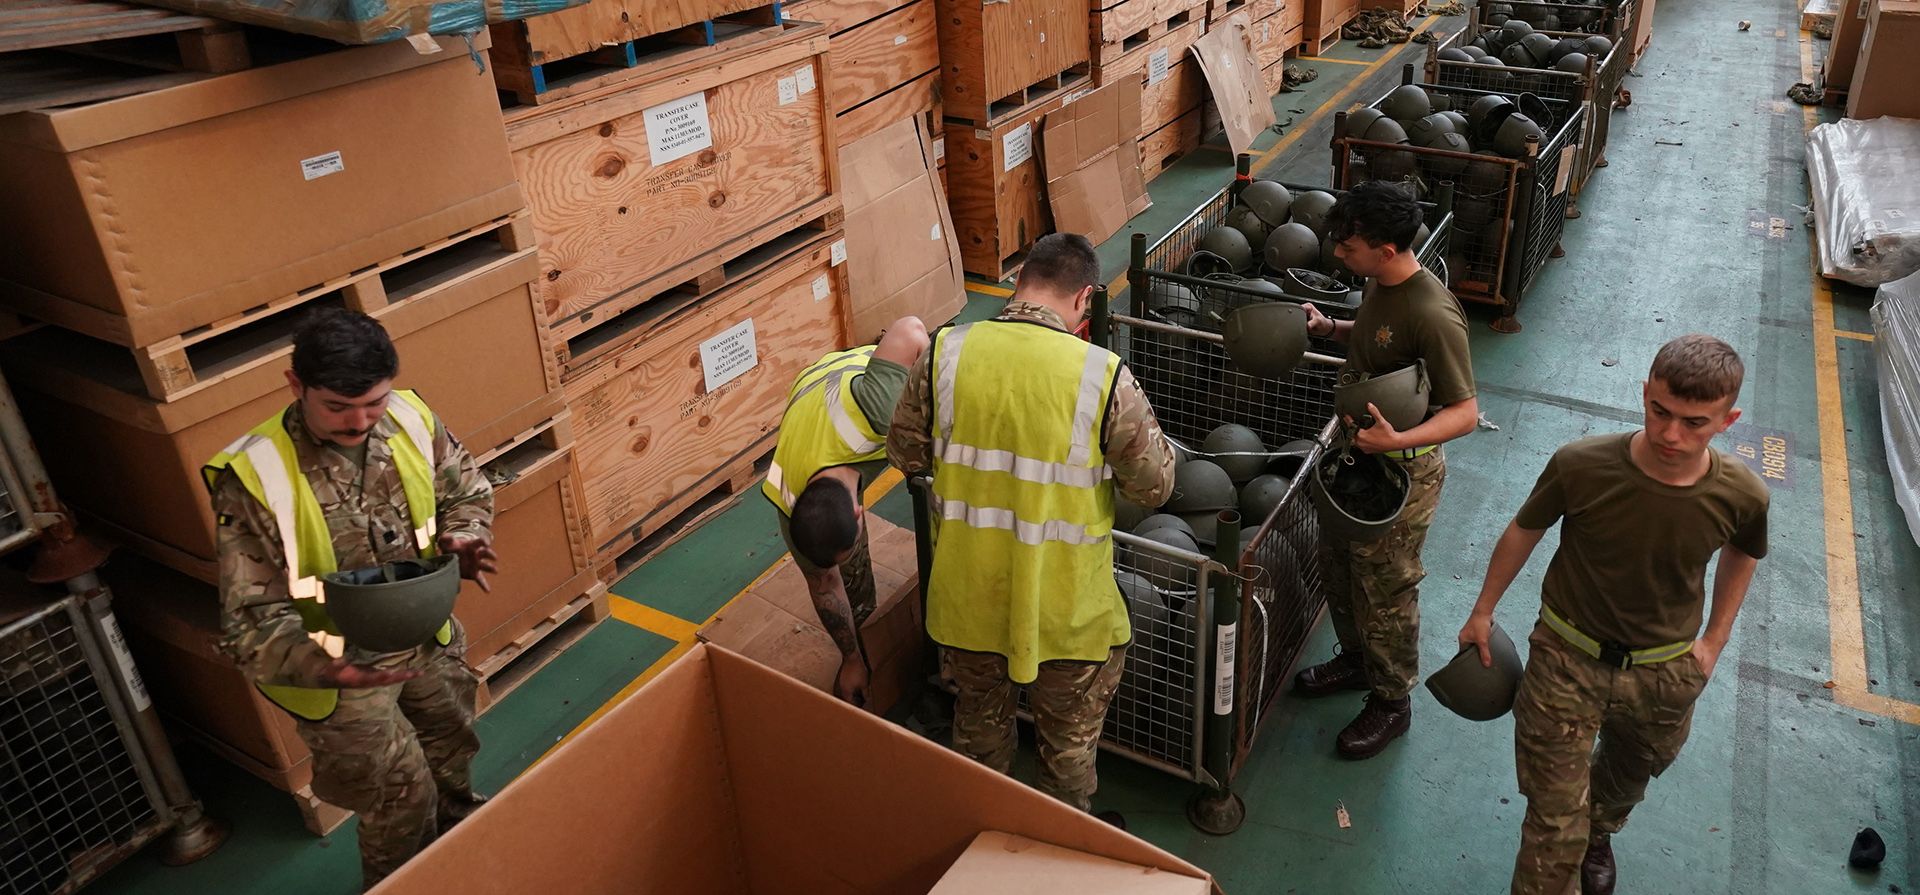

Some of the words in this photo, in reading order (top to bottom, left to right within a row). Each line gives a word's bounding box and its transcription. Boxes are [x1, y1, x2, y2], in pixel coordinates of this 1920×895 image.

[656, 106, 685, 120] TRANSFER
[685, 102, 699, 111] CASE
[670, 114, 689, 124] COVER
[646, 168, 684, 187] TRANSFER
[646, 184, 666, 198] PART
[710, 336, 736, 352] TRANSFER
[736, 328, 748, 339] CASE
[722, 341, 739, 353] COVER
[1736, 445, 1755, 459] 97
[1762, 436, 1786, 480] CB0914
